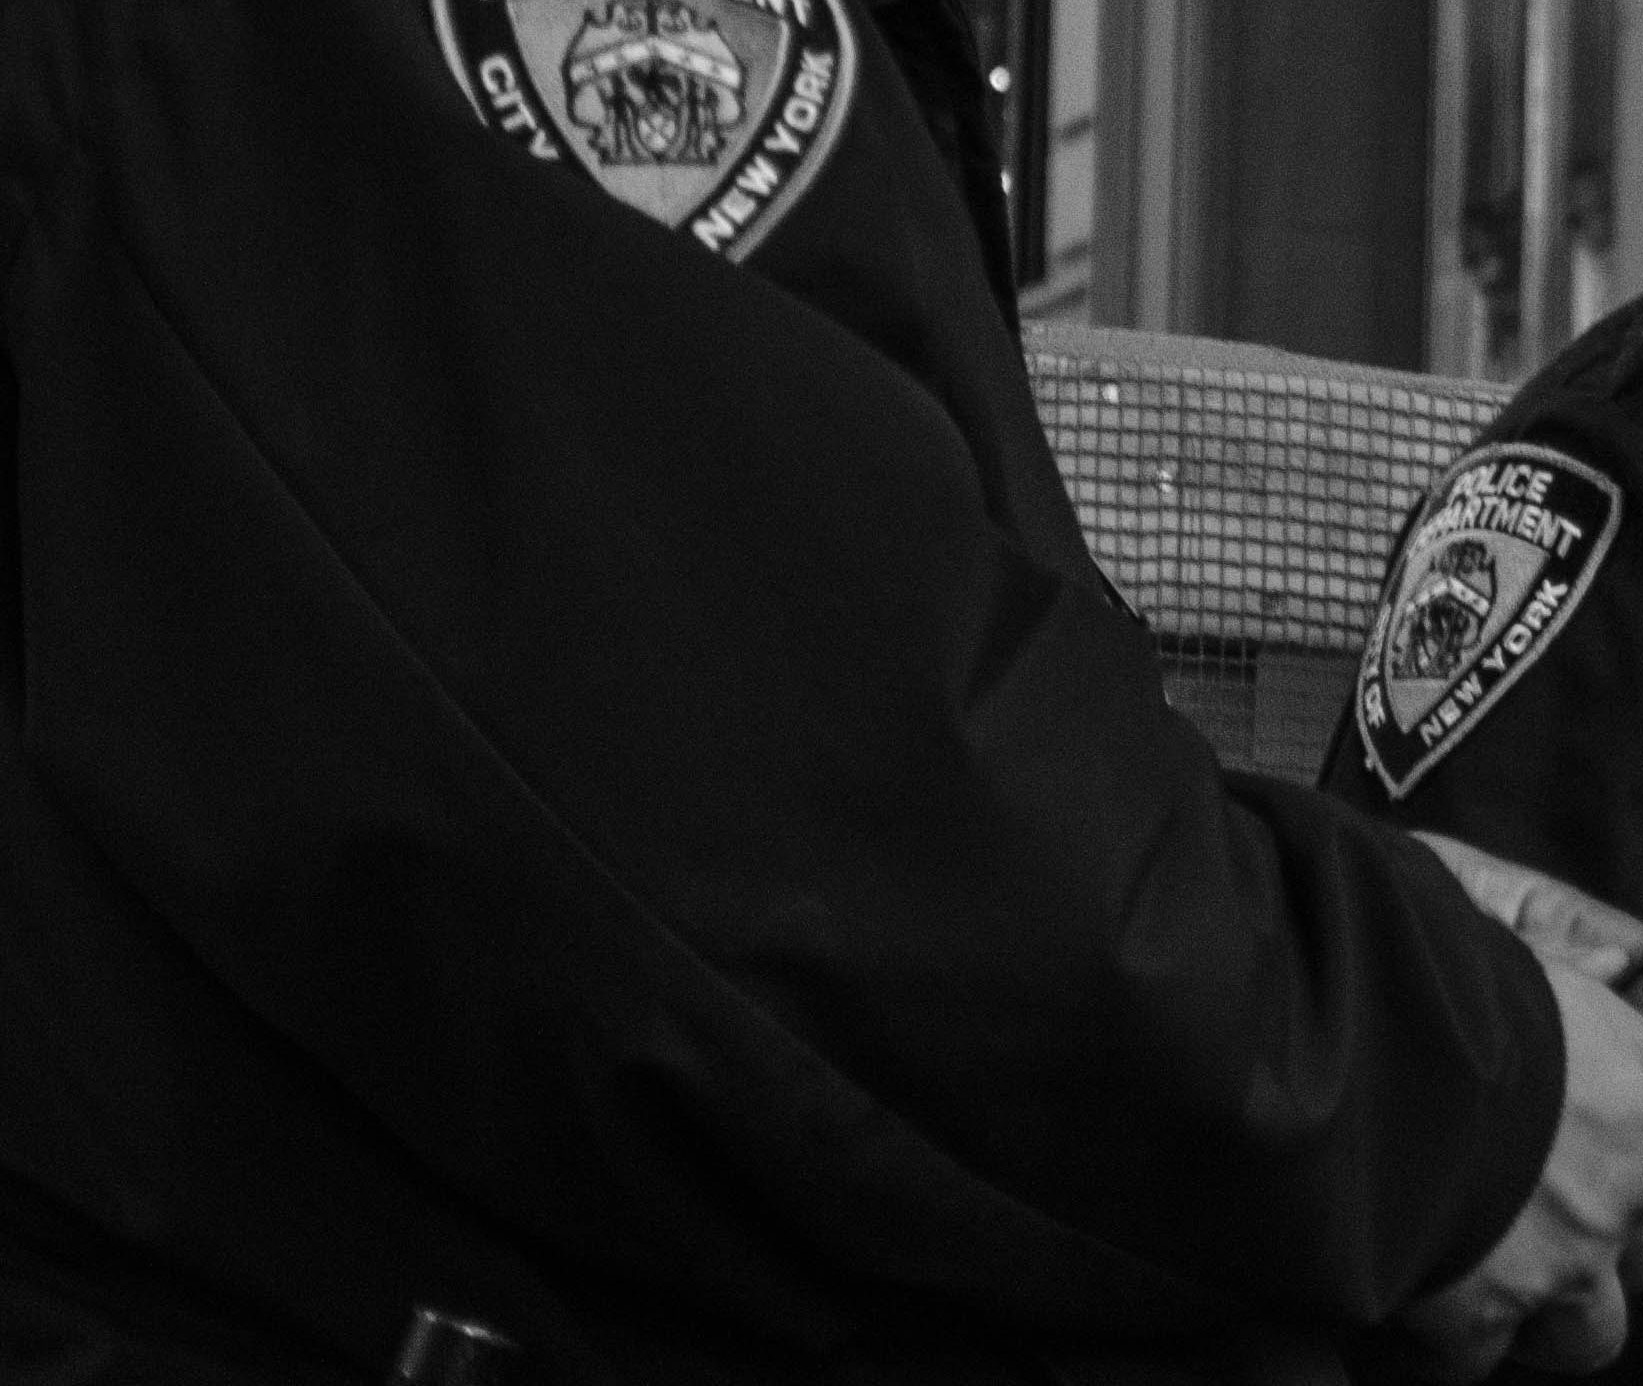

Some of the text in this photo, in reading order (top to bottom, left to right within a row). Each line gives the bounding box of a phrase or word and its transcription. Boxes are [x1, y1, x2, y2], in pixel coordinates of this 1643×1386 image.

[479, 52, 561, 161] CITY
[691, 48, 834, 252] NEW YORK
[1407, 495, 1582, 559] RTMENT
[1419, 578, 1569, 747] NEW YORK
